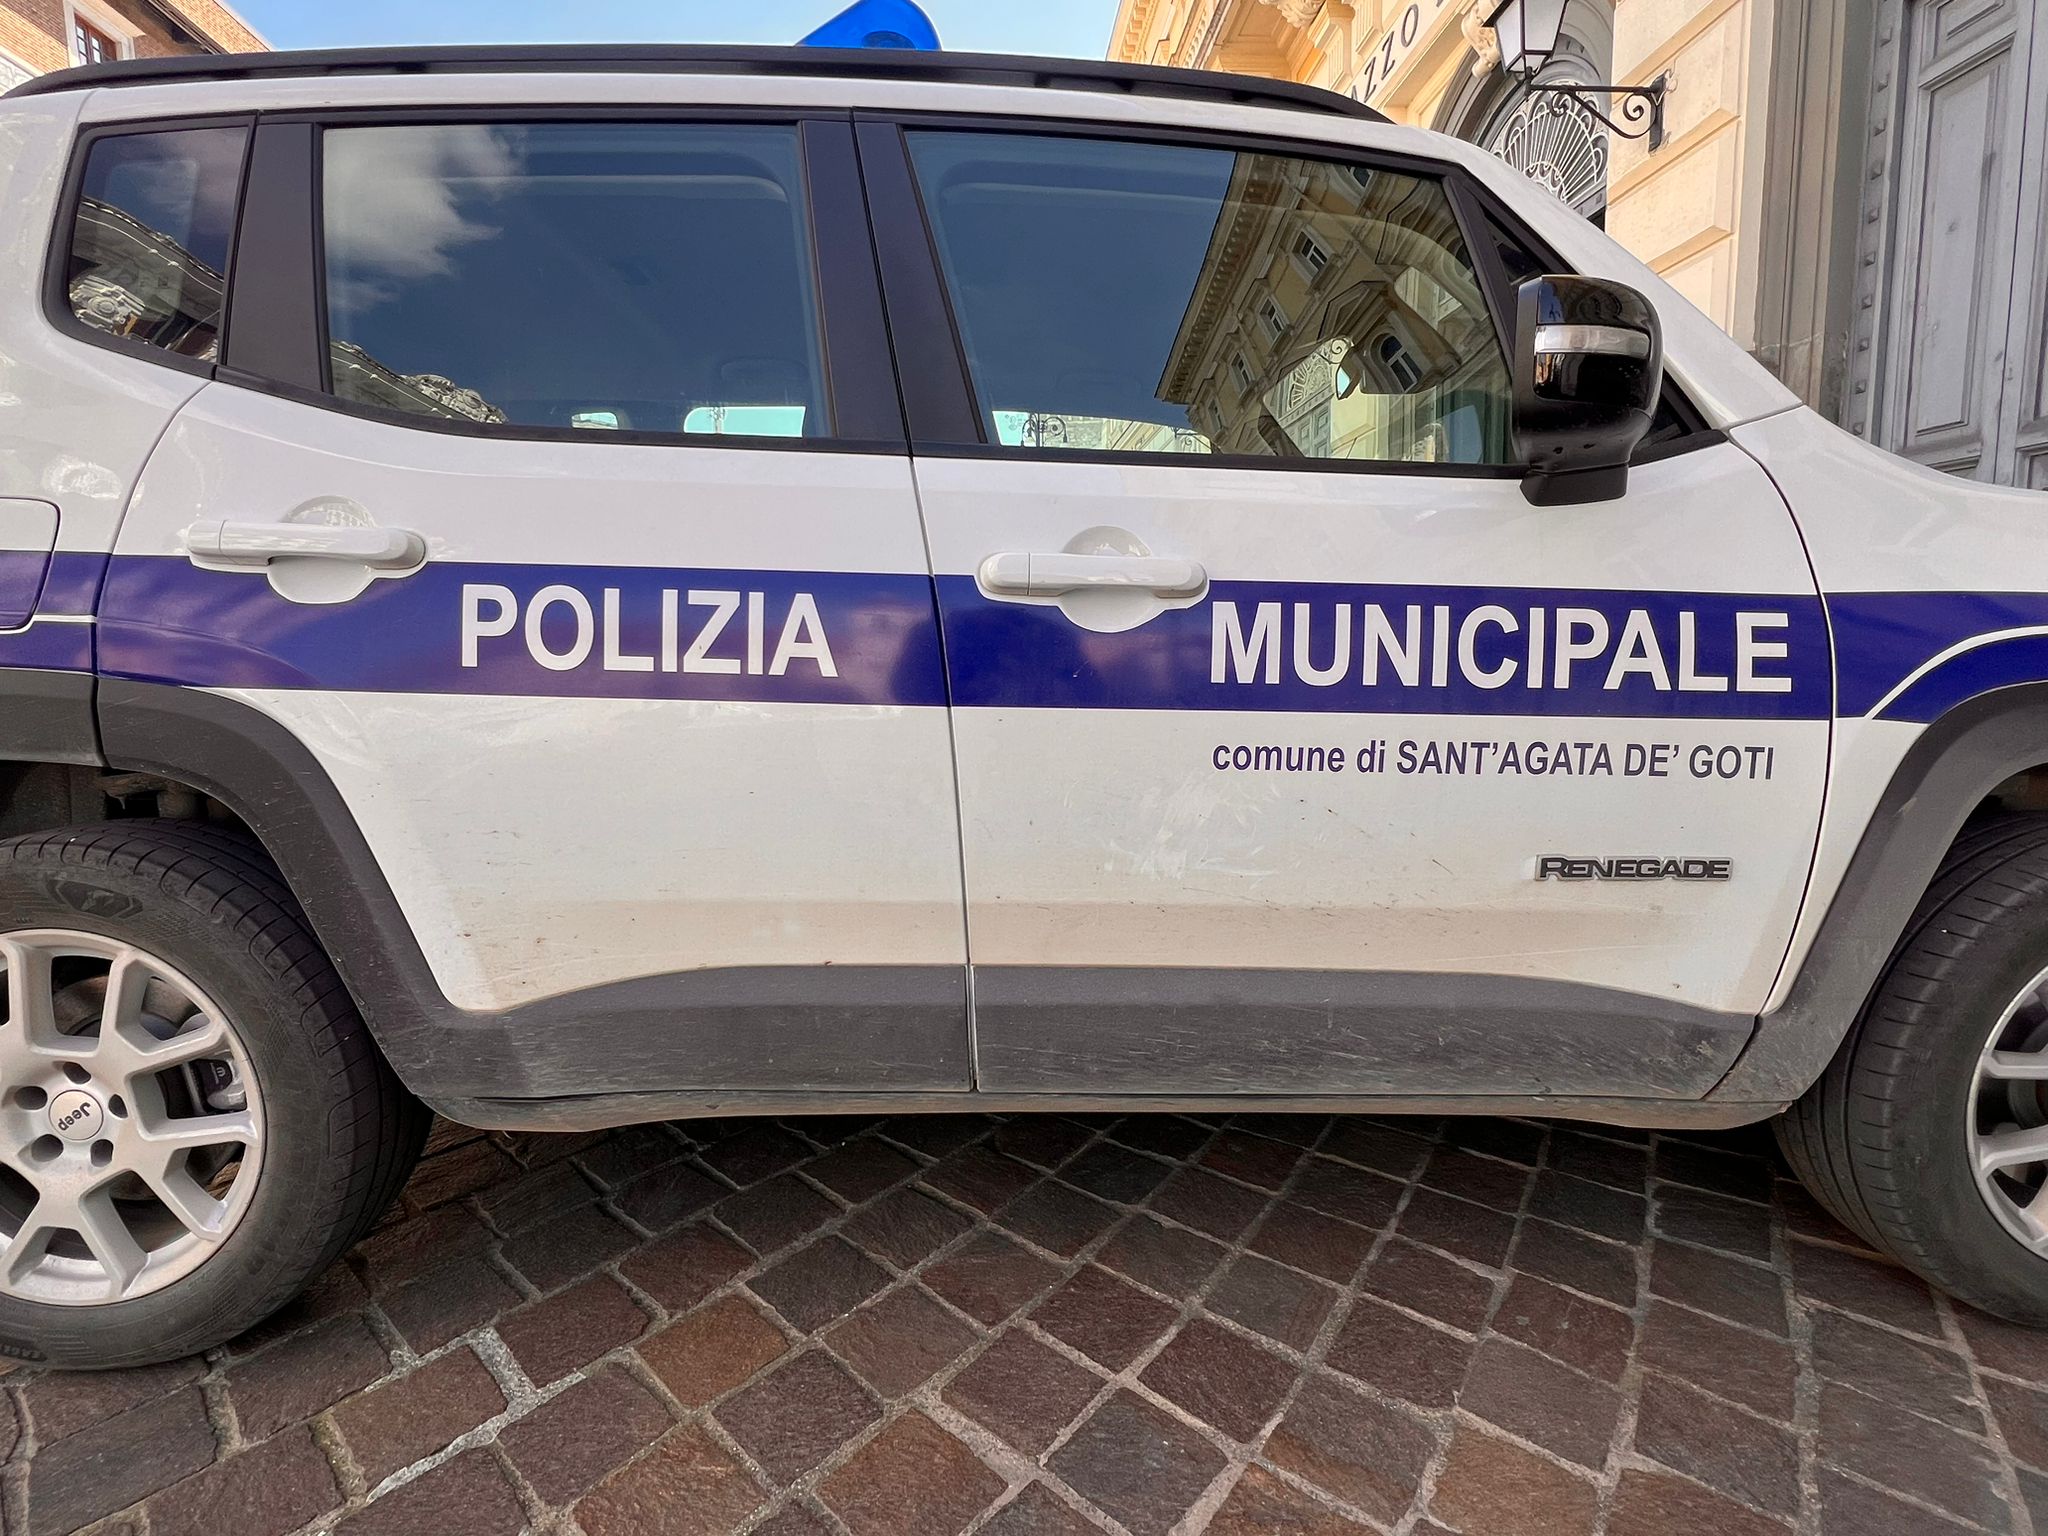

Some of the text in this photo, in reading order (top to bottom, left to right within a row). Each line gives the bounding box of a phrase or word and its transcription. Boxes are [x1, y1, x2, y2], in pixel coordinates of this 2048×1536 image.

[461, 583, 1792, 693] POLIZIA MUNICIPALE
[1212, 739, 1774, 780] comune di SANT'AGATA DE' GOTI
[1538, 855, 1732, 880] RENEGADE
[57, 1102, 91, 1131] Jeep
